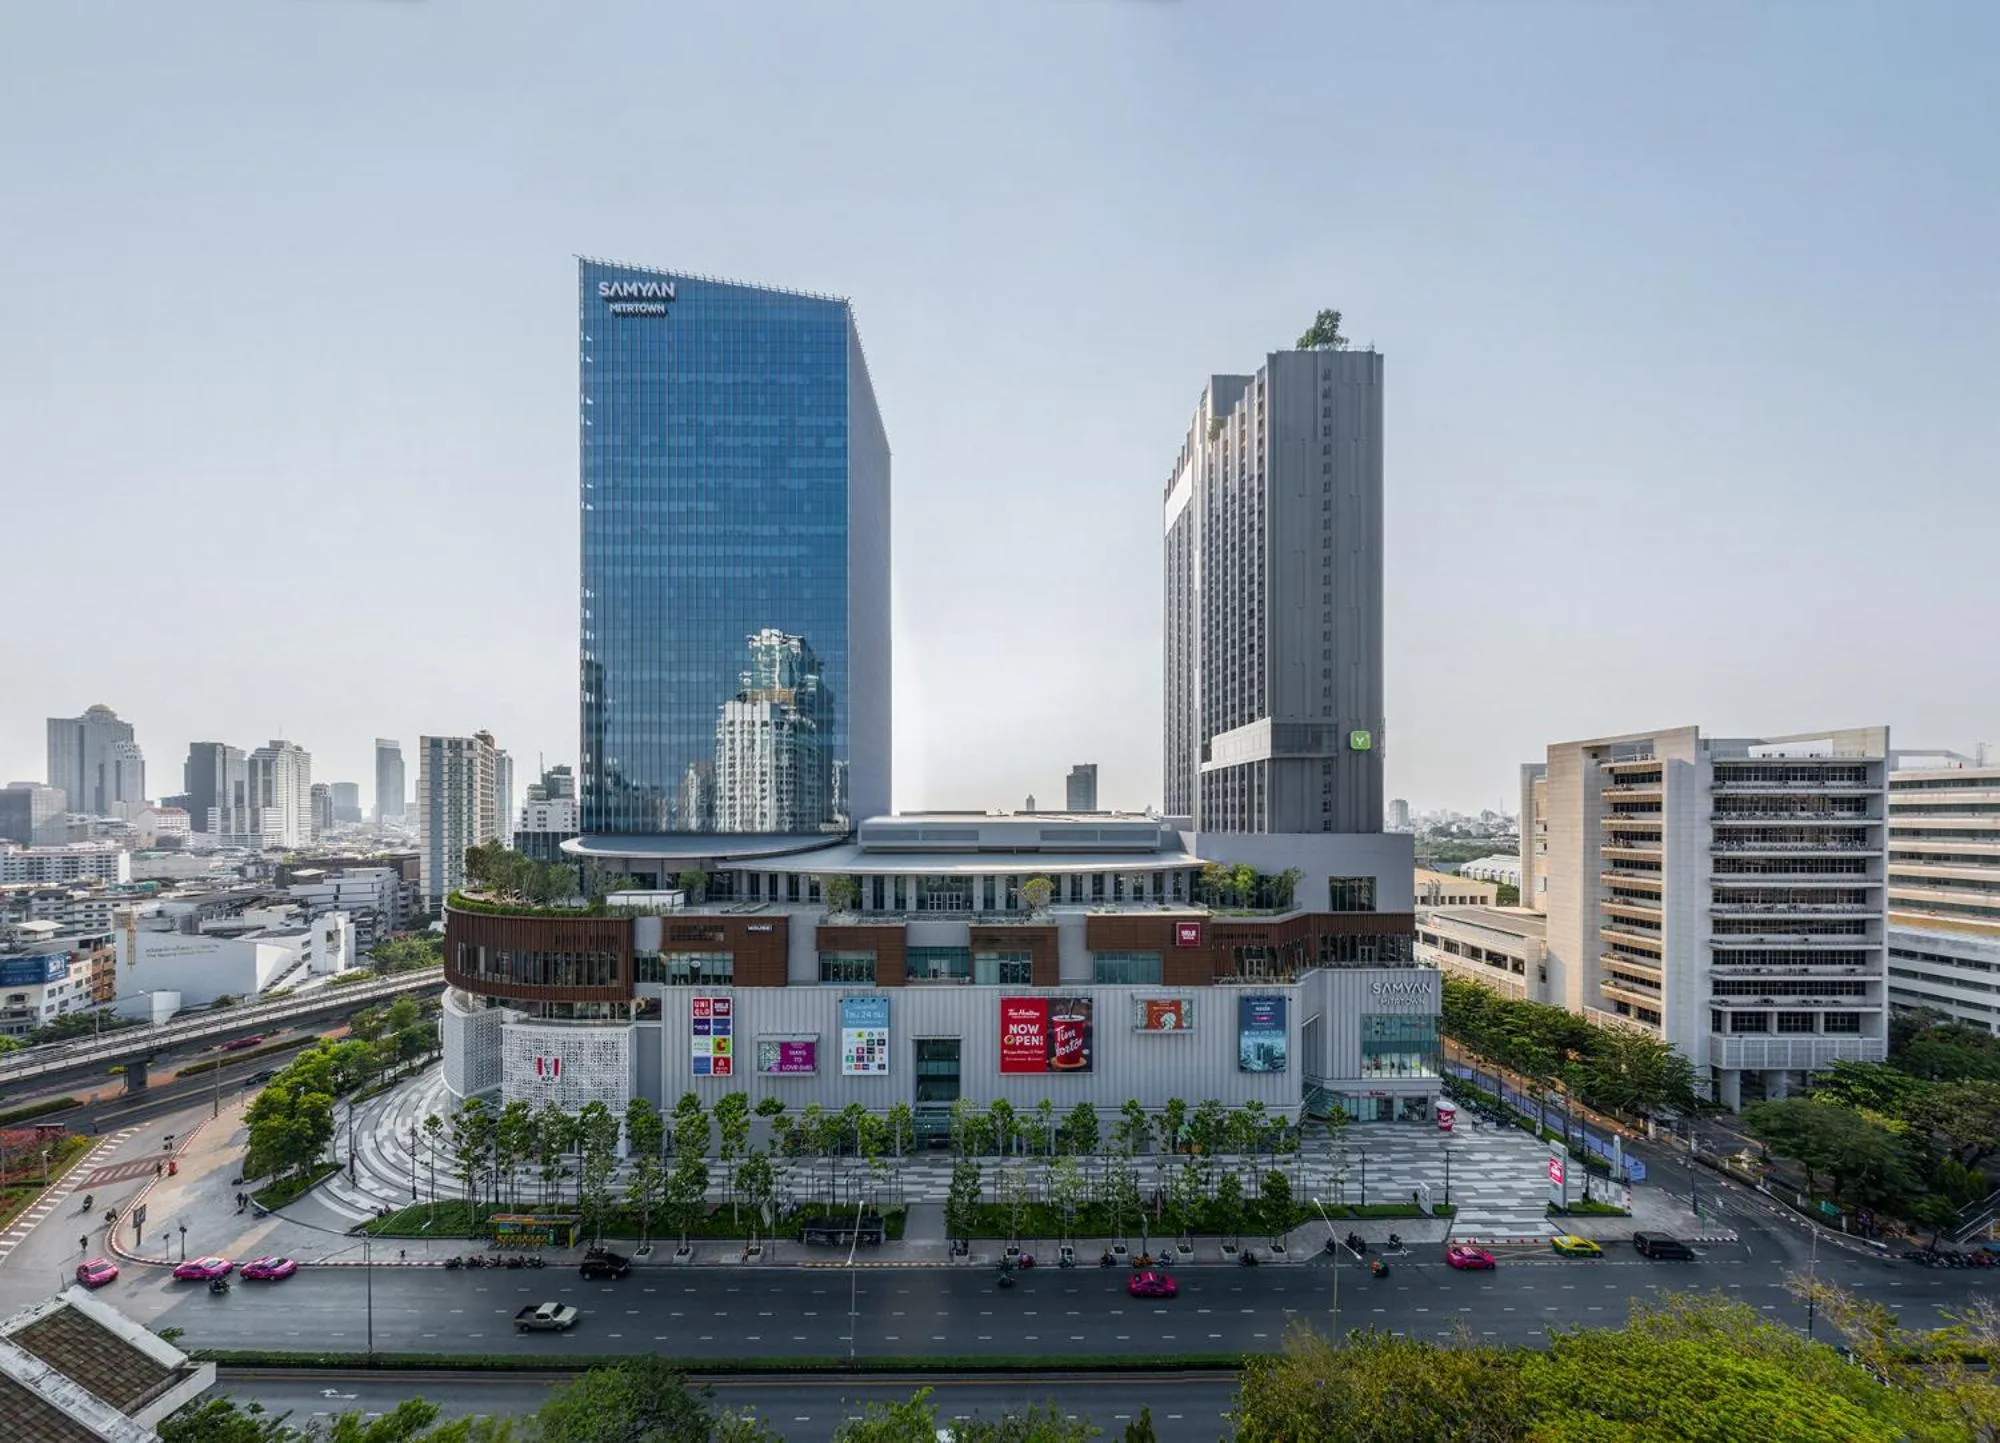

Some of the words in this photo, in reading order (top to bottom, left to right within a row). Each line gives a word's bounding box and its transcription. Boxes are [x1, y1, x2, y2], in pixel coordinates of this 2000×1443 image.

[598, 281, 675, 297] SAMYAN
[609, 303, 665, 314] MITRTOWN
[1371, 982, 1432, 995] SAMYAN
[1009, 1024, 1040, 1034] NOW
[1054, 1025, 1076, 1042] Tim
